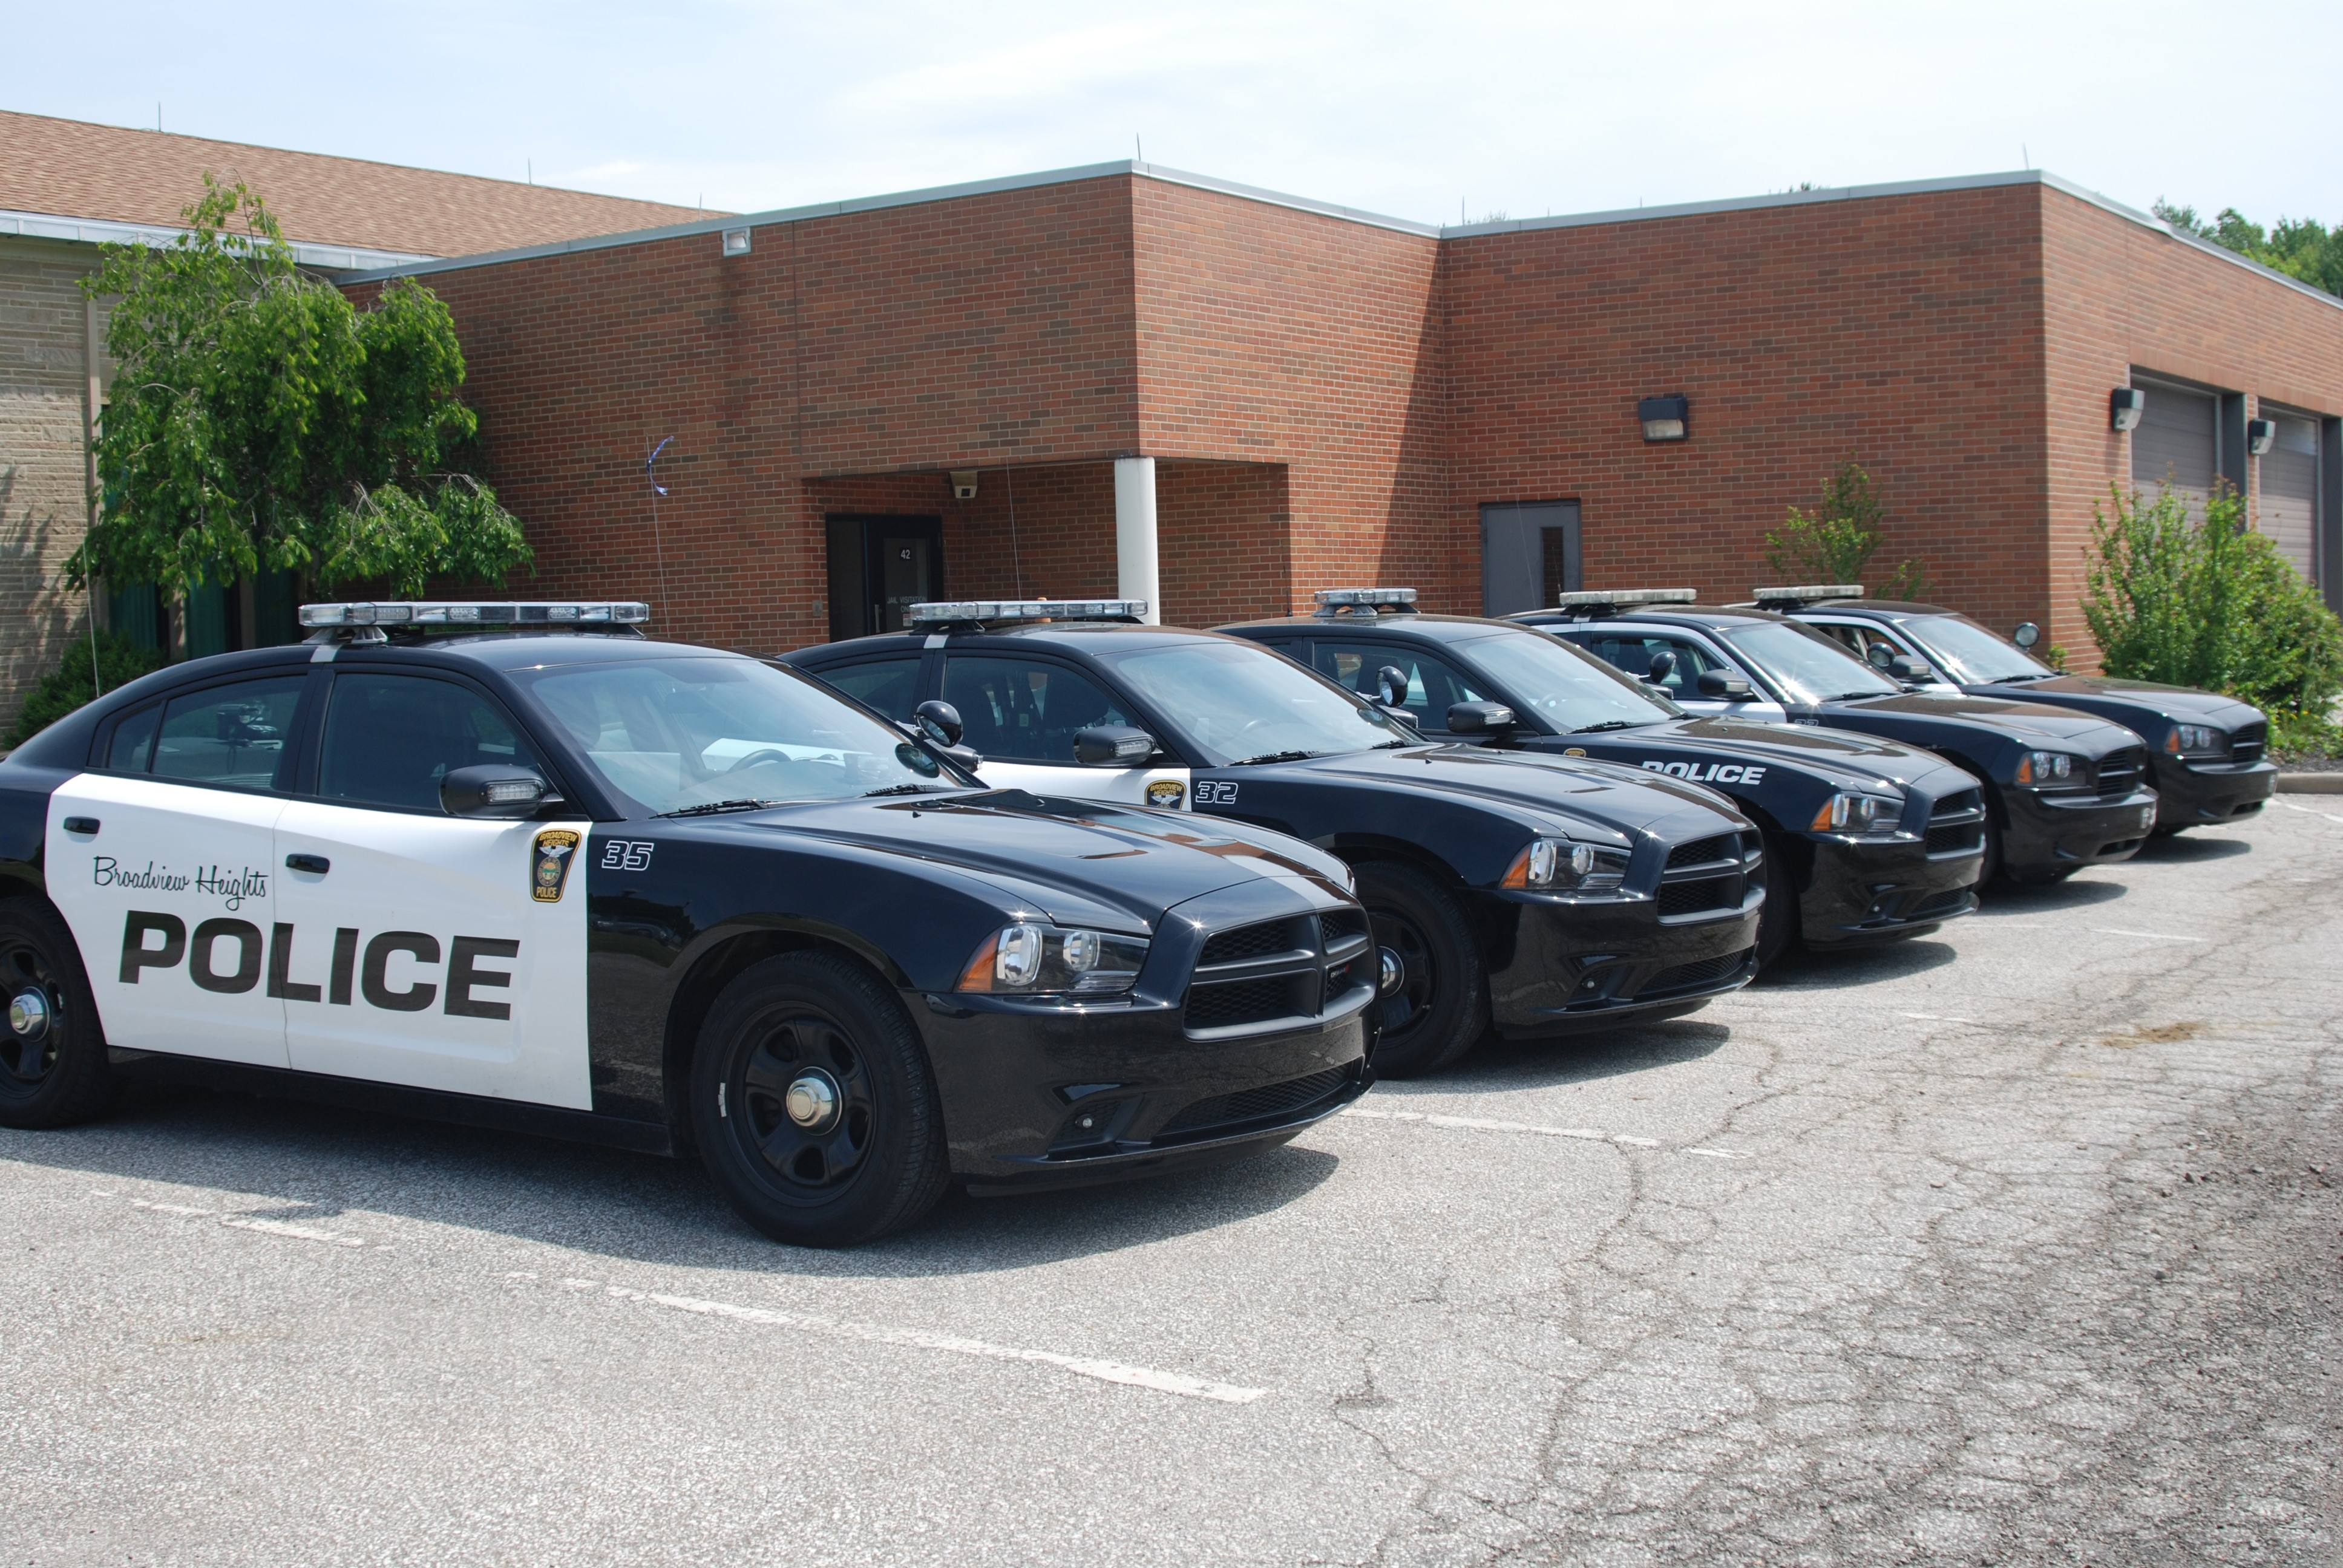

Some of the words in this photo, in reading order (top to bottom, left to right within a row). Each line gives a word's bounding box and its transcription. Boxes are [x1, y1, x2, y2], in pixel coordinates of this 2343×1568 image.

[901, 549, 911, 559] 42
[1150, 783, 1183, 792] BROADVIEW
[1196, 781, 1239, 804] 32
[539, 832, 577, 842] BROADVIEW
[601, 840, 655, 871] 35
[93, 856, 190, 891] Broadview
[195, 865, 269, 911] Heights
[537, 886, 557, 898] POLICE
[119, 910, 520, 1021] POLICE
